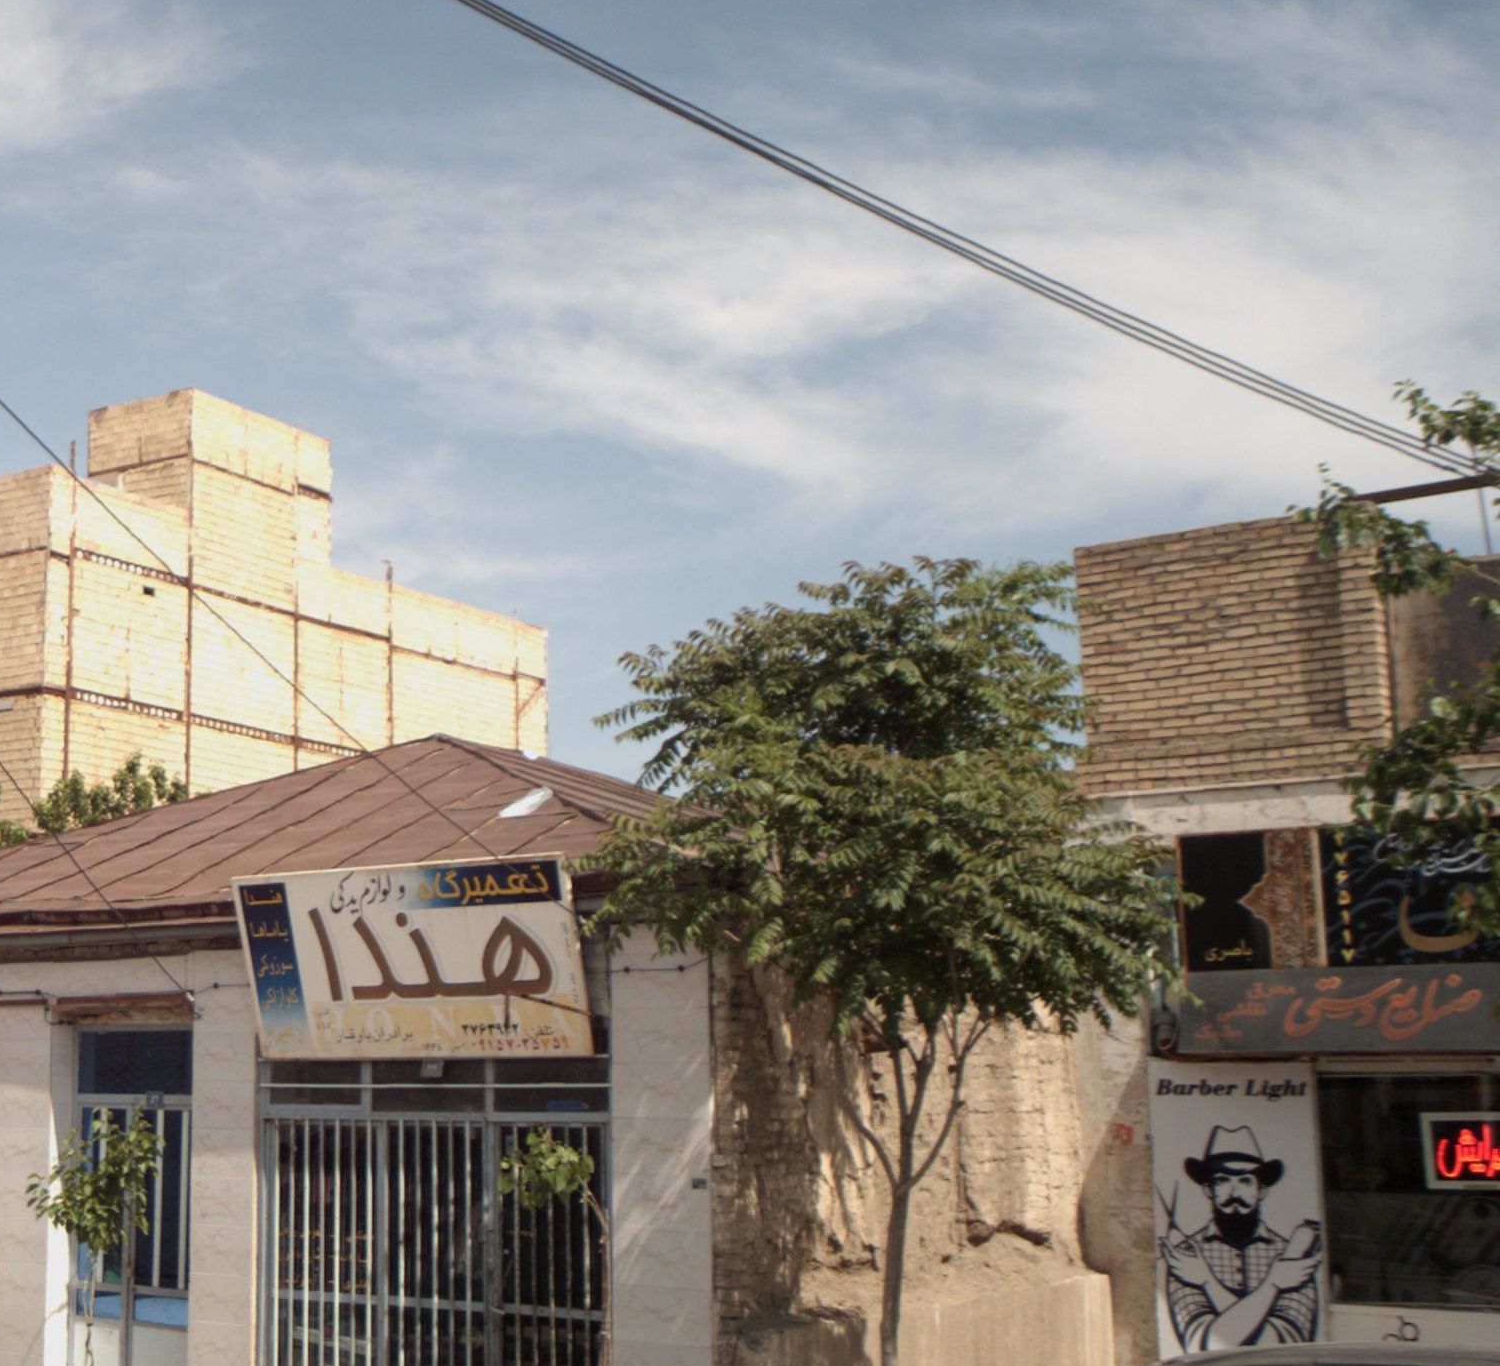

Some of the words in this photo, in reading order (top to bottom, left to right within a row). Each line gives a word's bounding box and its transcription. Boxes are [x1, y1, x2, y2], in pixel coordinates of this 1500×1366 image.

[330, 871, 358, 914] یدکی
[360, 874, 391, 917] لوازم
[398, 884, 406, 901] و
[418, 864, 549, 906] تعمیرگاه
[308, 906, 554, 1002] هندا
[1284, 975, 1402, 1037] دستی
[1379, 973, 1483, 1041] صنایع
[1156, 1078, 1238, 1096] Barber
[1245, 1078, 1307, 1102] Light
